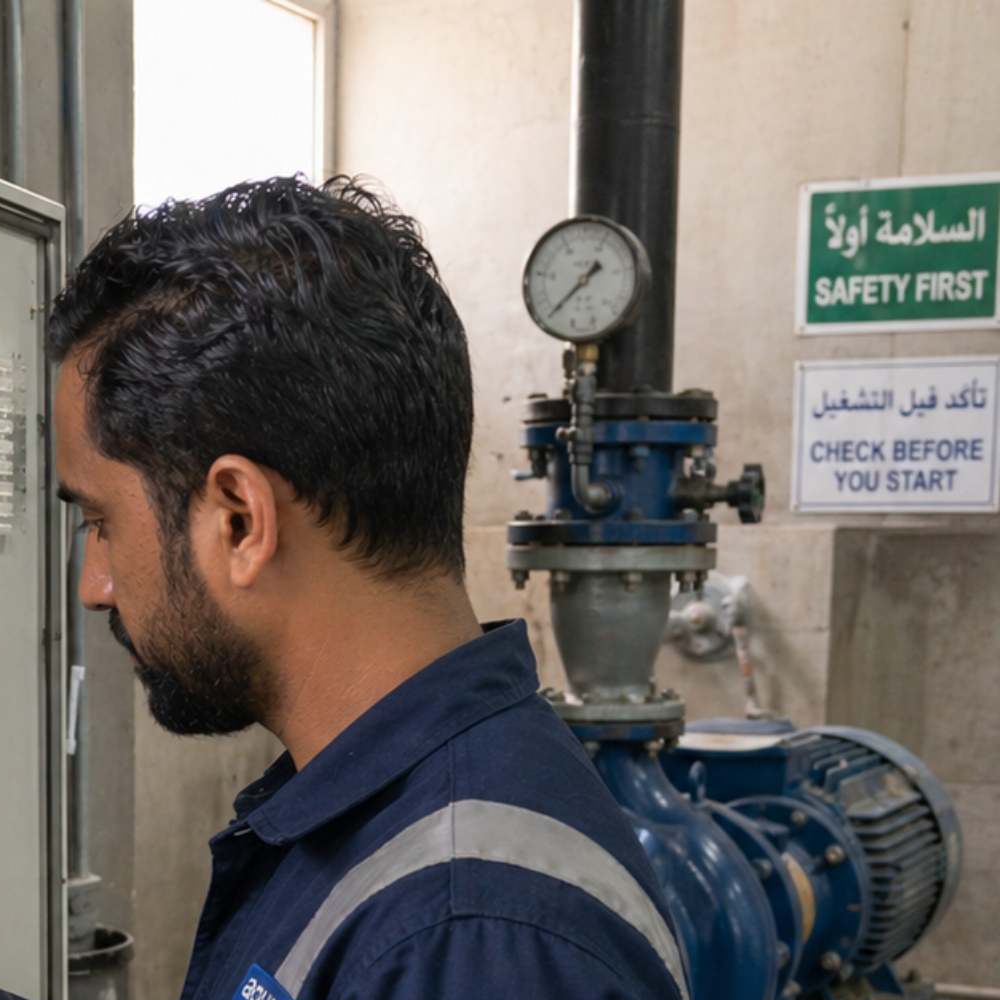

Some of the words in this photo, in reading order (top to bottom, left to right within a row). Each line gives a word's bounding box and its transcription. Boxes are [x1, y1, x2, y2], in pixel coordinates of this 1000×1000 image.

[876, 206, 987, 246] السلامة
[814, 273, 911, 307] SAFETY
[915, 269, 989, 303] FIRST
[810, 440, 885, 464] CHECK
[892, 438, 983, 463] BEFORE
[833, 469, 880, 493] YOU
[886, 468, 958, 493] START
